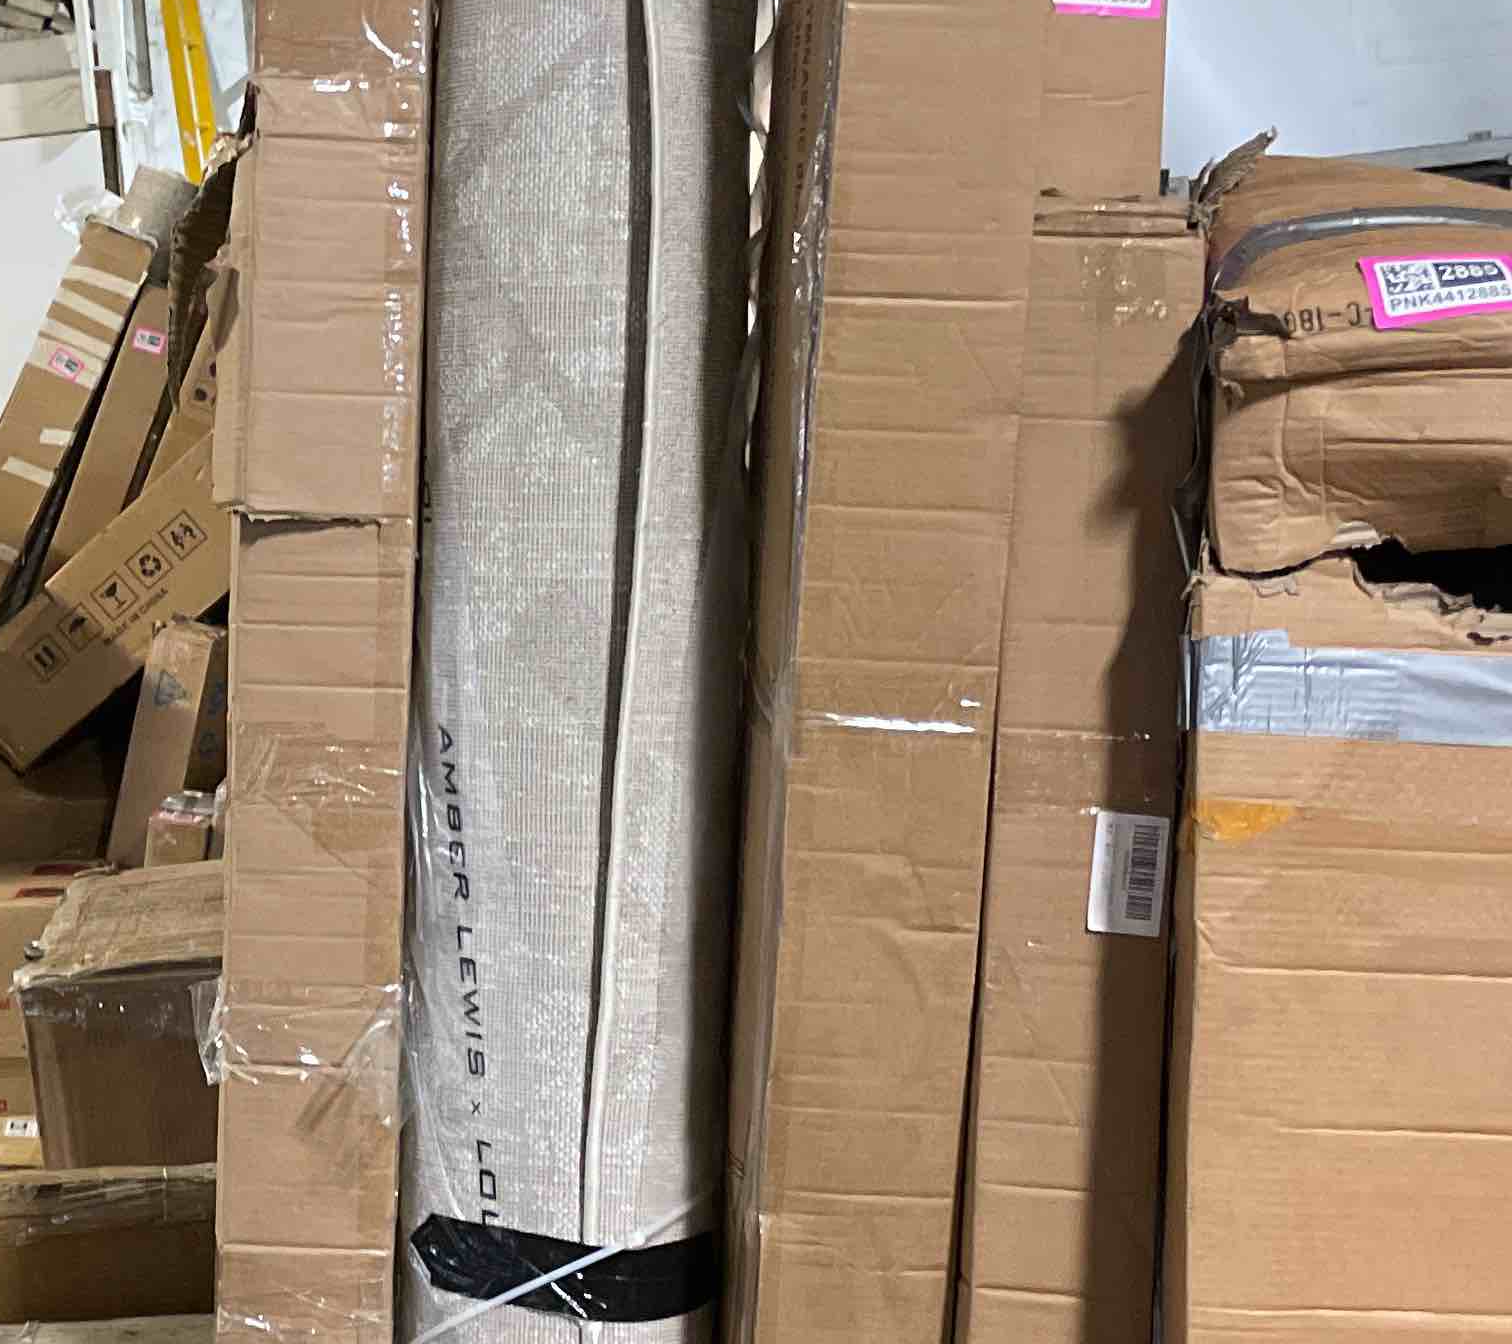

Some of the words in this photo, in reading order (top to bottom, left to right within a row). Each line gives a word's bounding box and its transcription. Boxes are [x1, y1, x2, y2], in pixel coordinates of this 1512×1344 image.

[1389, 283, 1512, 312] PNK4412885
[437, 724, 472, 903] AMBER
[455, 923, 487, 1078] LEWIS
